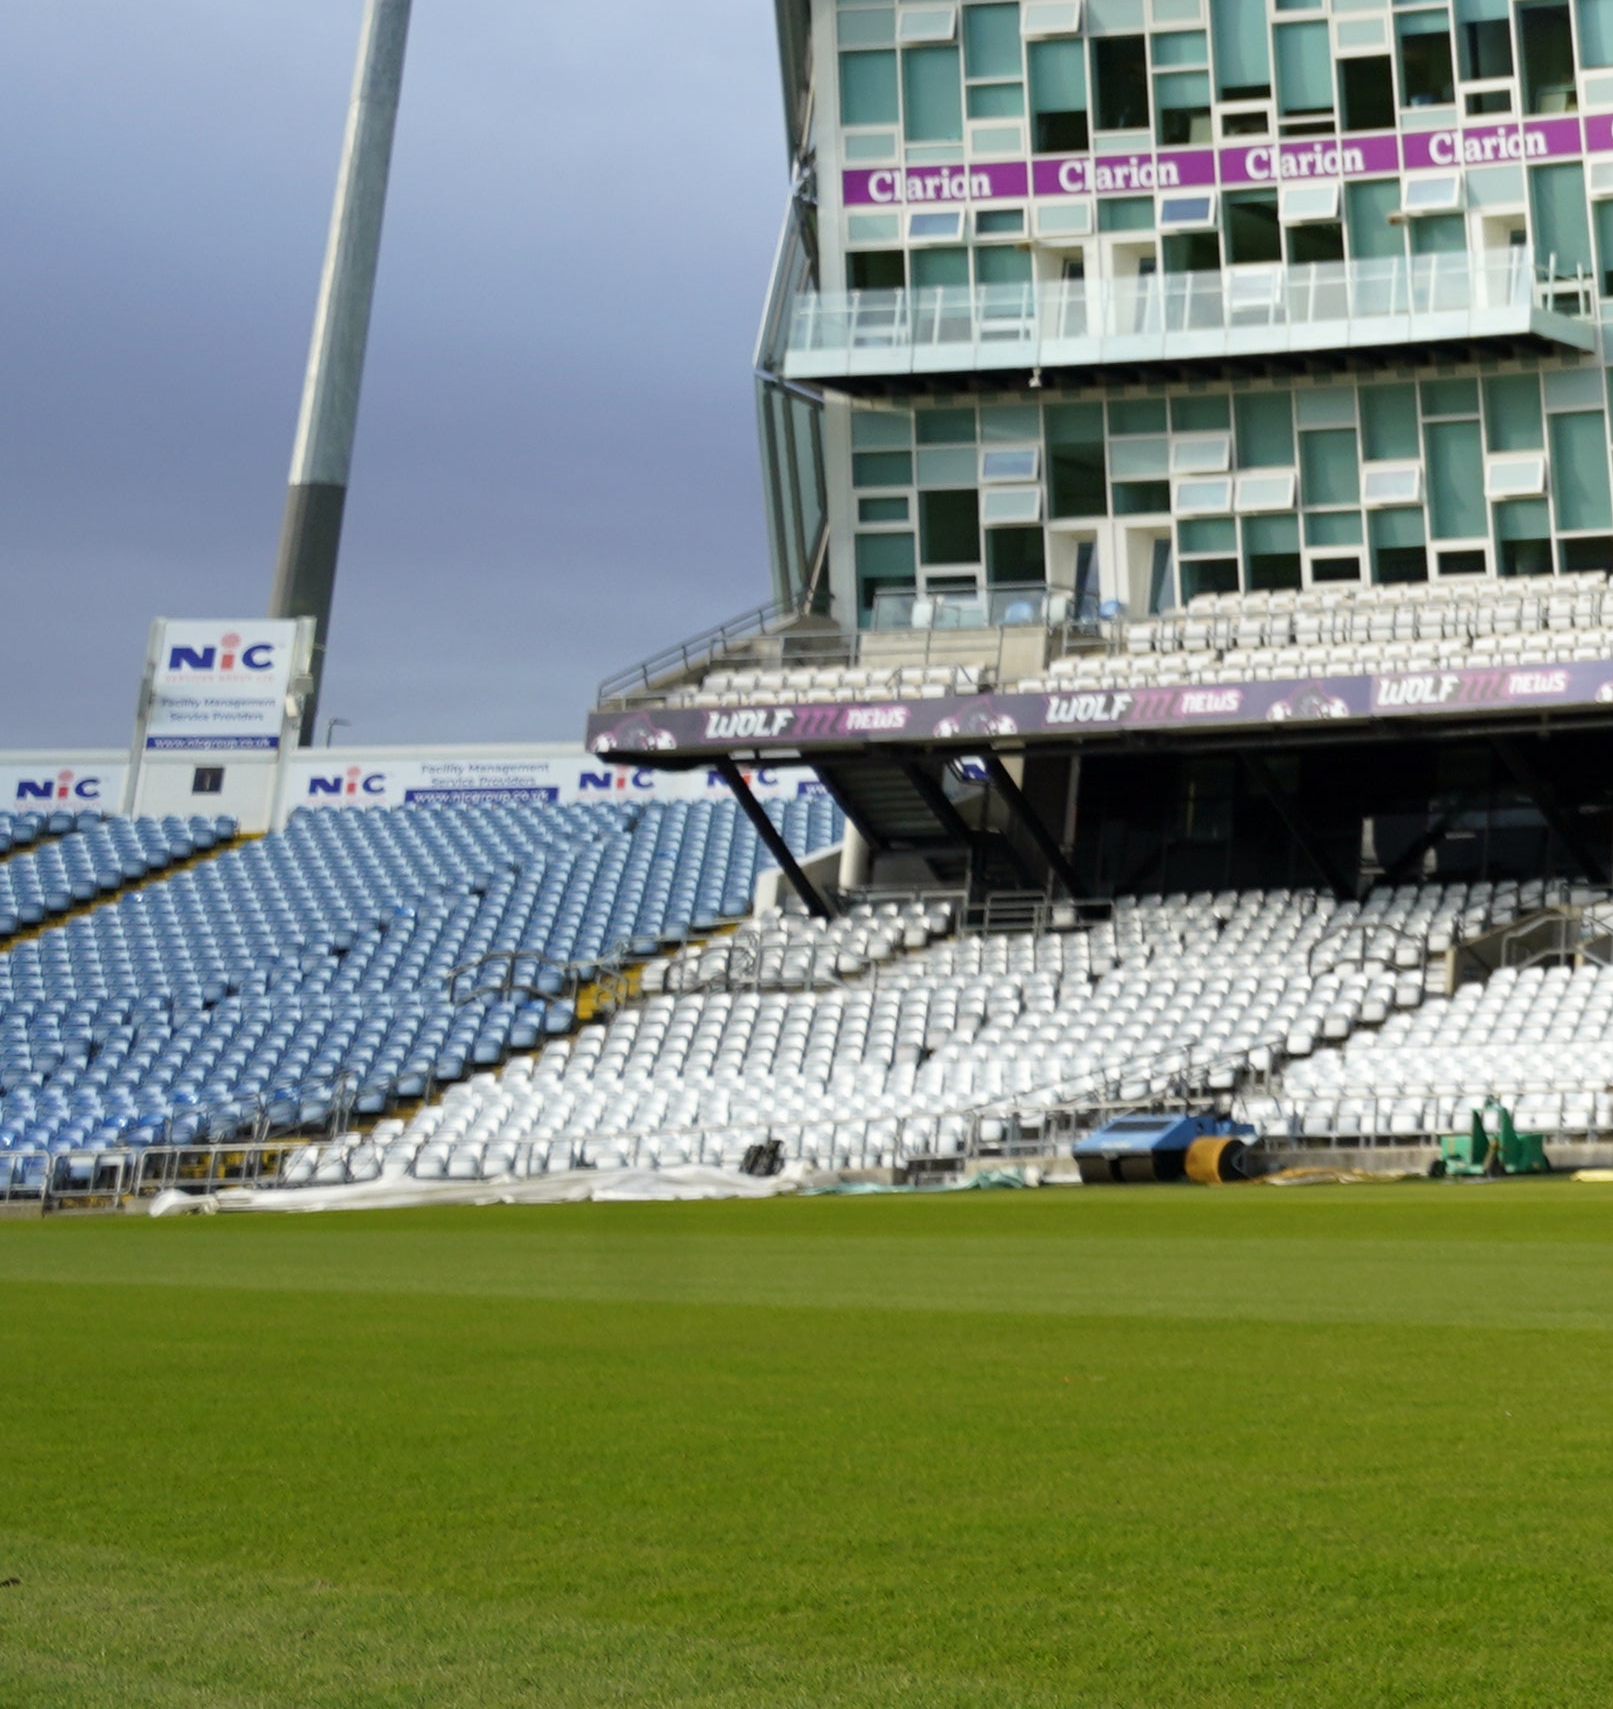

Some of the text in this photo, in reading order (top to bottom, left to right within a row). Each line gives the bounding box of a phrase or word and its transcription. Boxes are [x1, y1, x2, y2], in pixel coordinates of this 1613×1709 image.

[1429, 126, 1547, 164] Clarion
[1245, 143, 1364, 181] Clarion
[868, 168, 992, 203] Clarion
[1058, 157, 1179, 193] Clarion
[204, 698, 276, 709] Management
[169, 711, 264, 722] Service Providers
[421, 762, 549, 775] Facility Management
[432, 776, 536, 787] Service Providers
